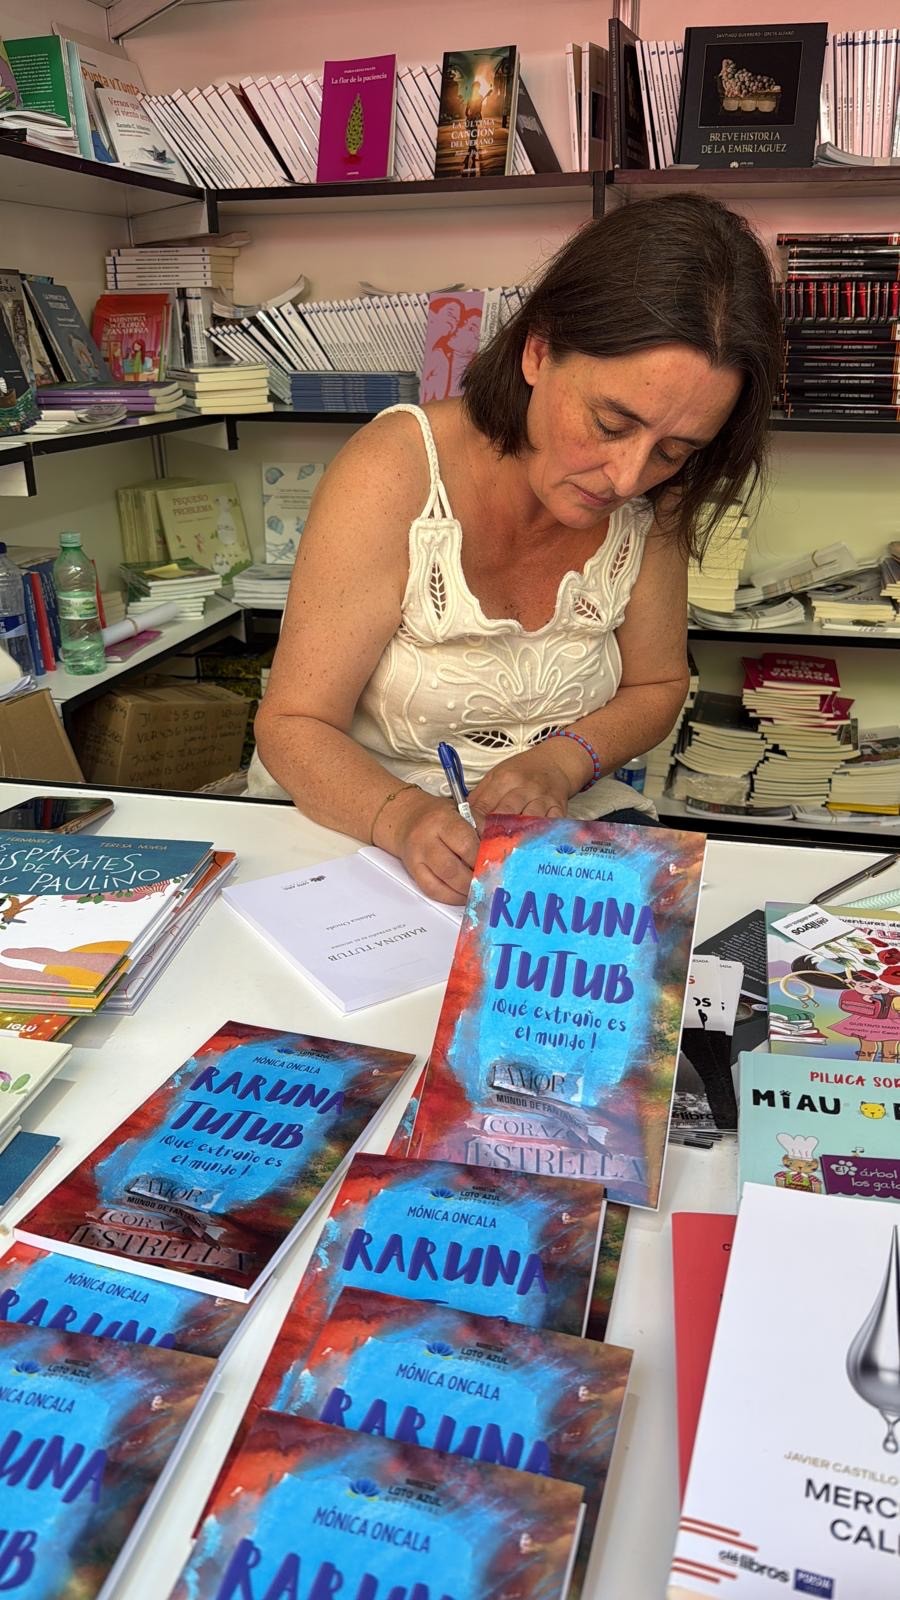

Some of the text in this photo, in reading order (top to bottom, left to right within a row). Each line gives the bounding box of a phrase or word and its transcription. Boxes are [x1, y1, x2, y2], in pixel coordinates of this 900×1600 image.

[339, 76, 349, 84] flor
[363, 73, 388, 83] paciencia
[709, 131, 780, 142] BREVE HISTORIA
[701, 143, 787, 154] DE LA EMBRIAGUEZ
[22, 862, 50, 874] DE
[538, 862, 614, 882] MÓNICA ONCALA
[489, 887, 660, 944] RARUNA
[375, 926, 428, 947] RARUNA
[328, 944, 376, 962] TUTUB
[493, 943, 635, 1004] TUTUB
[7, 1021, 38, 1033] IGLÚ
[534, 1004, 602, 1029] extraño
[608, 1017, 626, 1032] es
[515, 1025, 531, 1042] el
[252, 1054, 320, 1074] MÓNICA ONCALA
[809, 1071, 867, 1087] PILUCA
[190, 1066, 346, 1115] RARUNA
[496, 1094, 527, 1108] MUNDO
[529, 1099, 541, 1110] DE
[170, 1100, 304, 1149] TUTUB
[171, 1154, 187, 1166] el
[200, 1142, 260, 1165] extraño
[265, 1157, 283, 1168] es
[474, 1142, 646, 1182] ESTRELLA
[852, 1177, 870, 1187] los
[860, 1168, 898, 1179] árbol
[127, 1196, 156, 1209] MUNDO
[157, 1203, 168, 1212] DE
[407, 1204, 497, 1229] MÓNICA ONCALA
[79, 1226, 246, 1271] ESTRELLA
[342, 1228, 549, 1296] RARUNA
[64, 1272, 150, 1304] MÓNICA ONCALA
[396, 1362, 500, 1401] MÓNICA ONCALA
[25, 1391, 76, 1414] ONCALA
[784, 1451, 899, 1487] JAVIER CASTILLO
[312, 1504, 431, 1554] MÓNICA ONCALA
[829, 1518, 900, 1556] CAL
